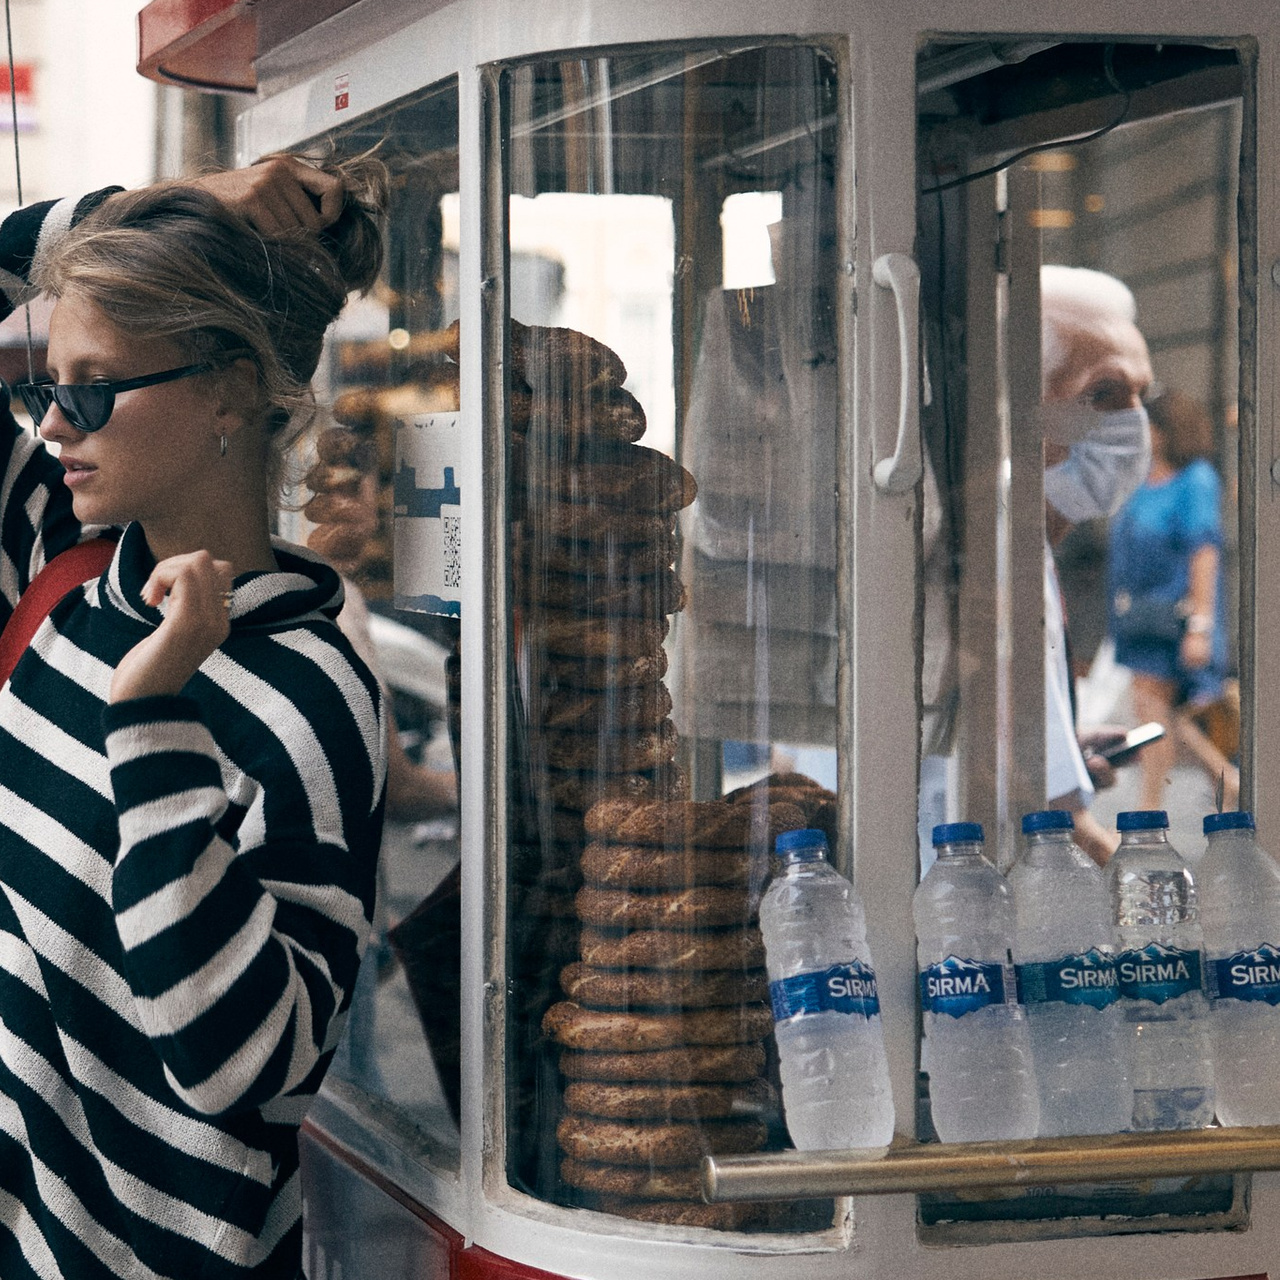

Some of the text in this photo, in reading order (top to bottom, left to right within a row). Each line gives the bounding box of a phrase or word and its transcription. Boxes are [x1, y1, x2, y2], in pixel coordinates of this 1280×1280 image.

[1120, 960, 1191, 982] SIRMA
[1230, 964, 1280, 985] SIRM
[928, 973, 991, 997] SIRMA
